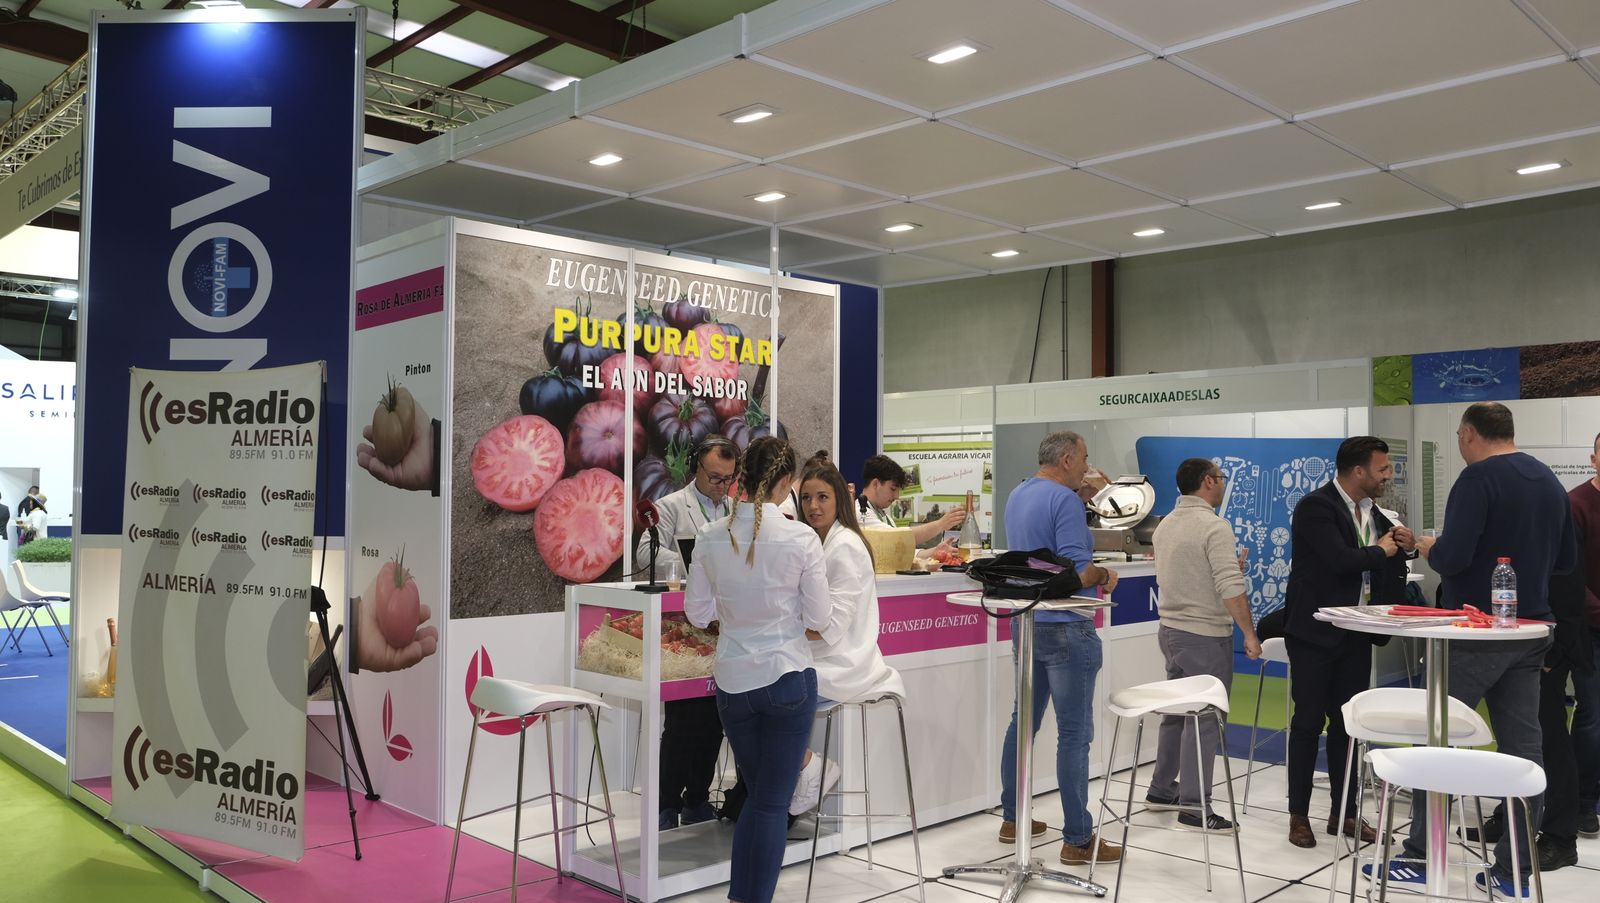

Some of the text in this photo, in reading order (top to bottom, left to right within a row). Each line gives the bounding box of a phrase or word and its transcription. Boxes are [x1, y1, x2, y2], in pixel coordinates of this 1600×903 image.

[18, 189, 27, 212] Te
[27, 170, 62, 206] Cubrimos
[62, 155, 73, 185] de
[214, 243, 227, 312] NOVI-FAM
[405, 363, 431, 377] Pinton
[582, 364, 605, 389] EL
[654, 371, 689, 396] DEL
[692, 375, 748, 401] SABOR
[1099, 388, 1220, 406] SEGURCAIXAADESLAS
[29, 410, 76, 419] SEMI
[164, 389, 315, 425] esRadio
[231, 426, 313, 447] ALMERÍA
[229, 449, 313, 460] 89.5FM 91.0 FM
[908, 453, 937, 461] ESCUELA
[141, 485, 180, 497] esRadio
[202, 487, 246, 499] esRadio
[139, 527, 180, 540] esRadio
[200, 531, 247, 544] esRadio
[361, 546, 379, 557] Rosa
[142, 573, 307, 599] ALMERÍA 89.5FM 91.0 FM
[879, 614, 979, 634] UGENSEED GENETICS
[152, 748, 299, 800] esRadio
[216, 792, 297, 825] ALMERÍA
[214, 812, 297, 839] 89.5FM 91.0 FM
